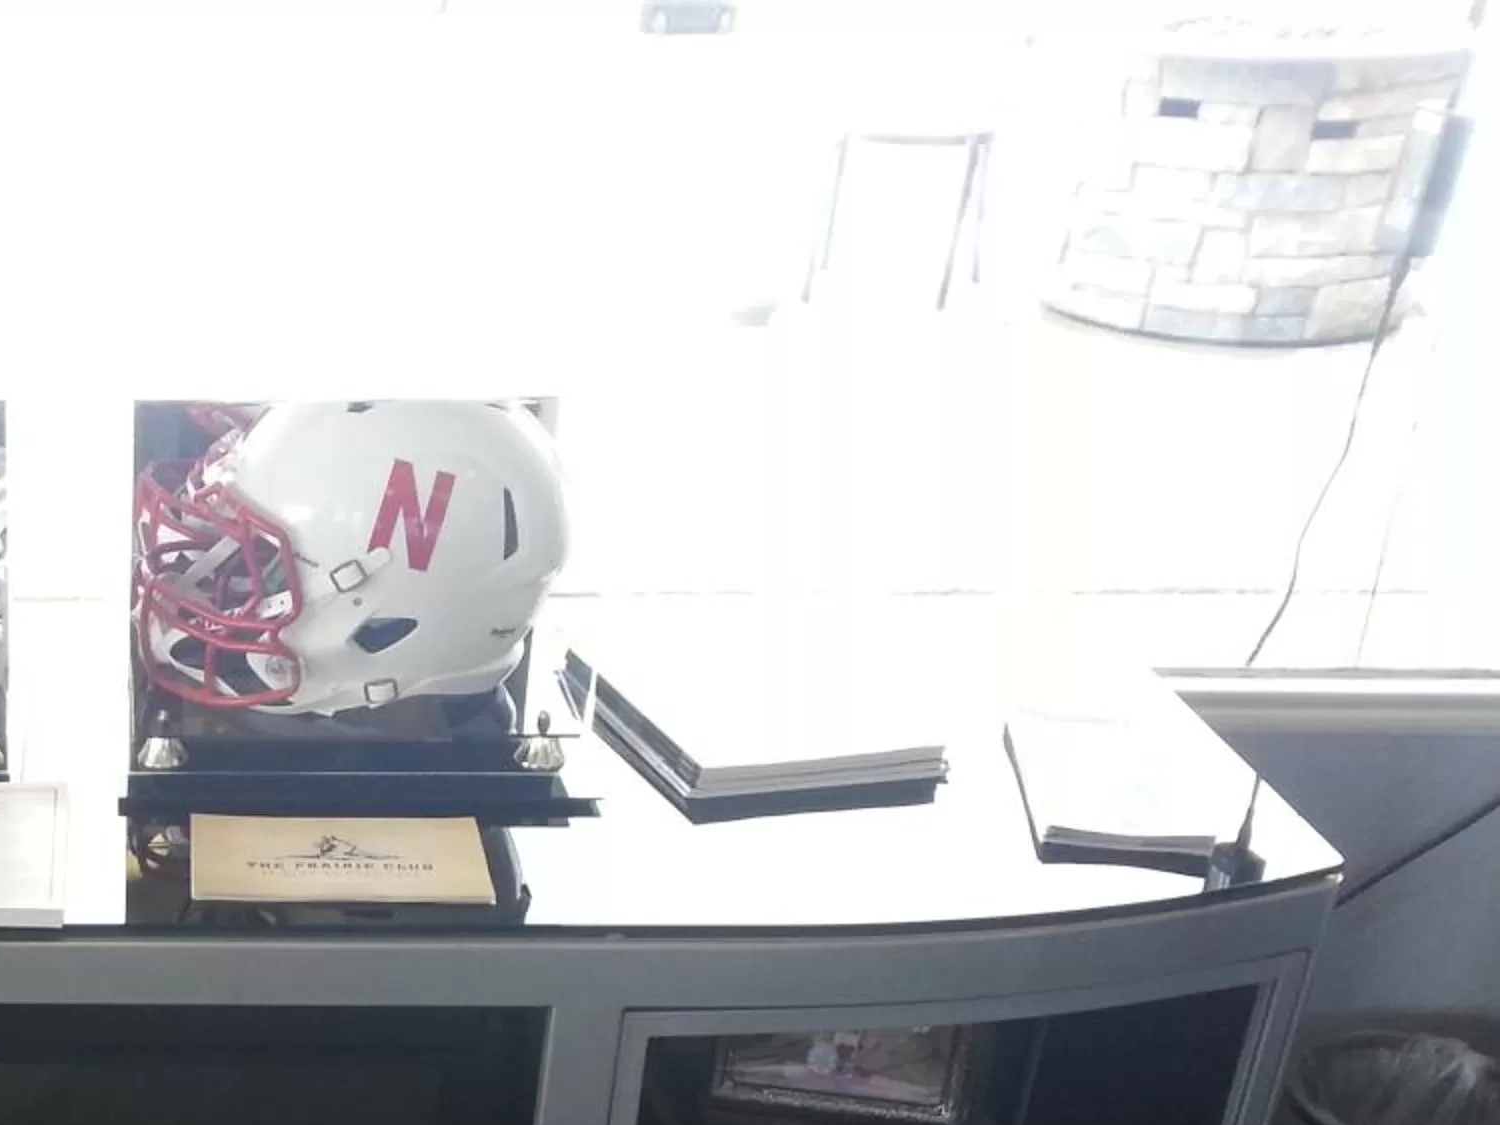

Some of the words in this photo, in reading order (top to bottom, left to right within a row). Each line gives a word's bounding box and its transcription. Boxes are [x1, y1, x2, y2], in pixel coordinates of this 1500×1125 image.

[367, 457, 457, 572] N
[246, 861, 284, 870] THE
[295, 862, 375, 870] PRAIRIE
[383, 863, 434, 871] CLUB
